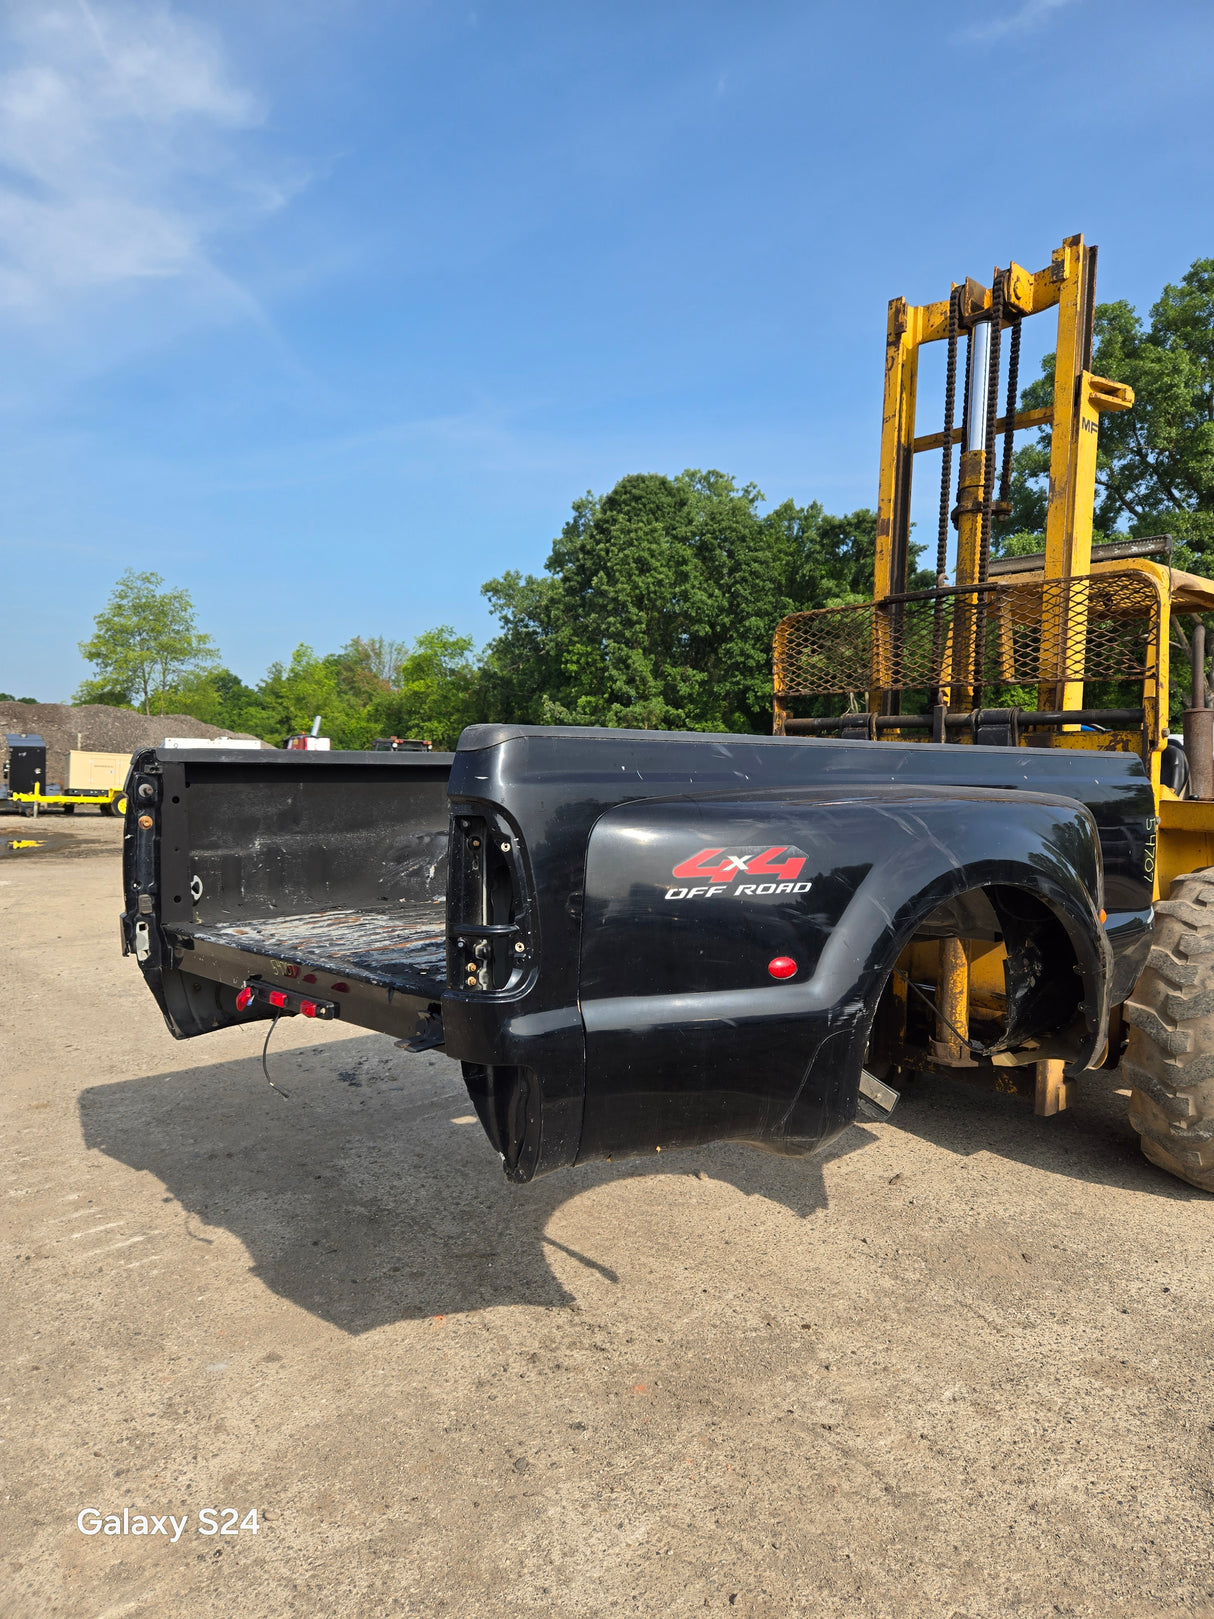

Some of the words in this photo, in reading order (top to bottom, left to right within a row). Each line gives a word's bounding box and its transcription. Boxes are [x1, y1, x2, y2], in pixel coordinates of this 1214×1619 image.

[1082, 417, 1098, 434] MF
[665, 885, 727, 900] OFF
[734, 882, 812, 896] ROAD
